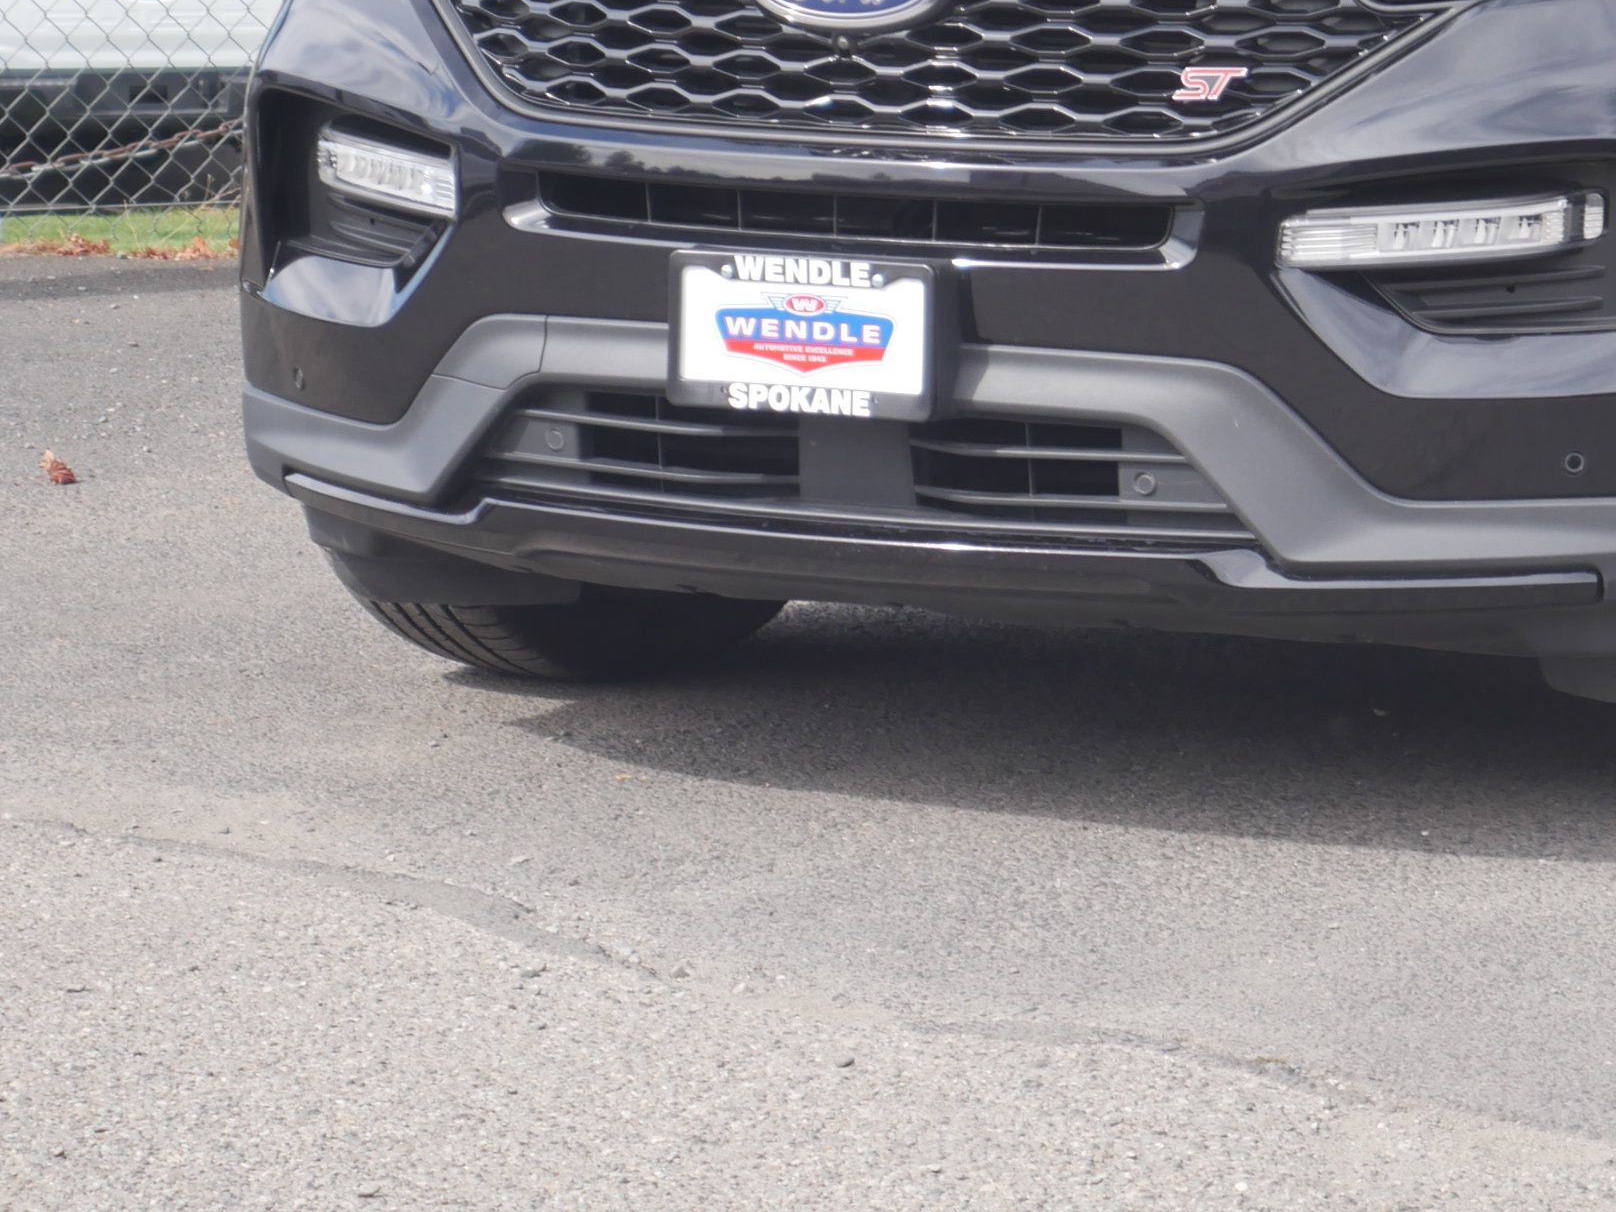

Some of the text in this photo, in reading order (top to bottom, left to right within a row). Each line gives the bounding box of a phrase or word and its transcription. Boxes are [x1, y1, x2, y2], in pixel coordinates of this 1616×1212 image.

[1172, 67, 1248, 100] ST
[734, 254, 871, 288] WENDLE
[791, 298, 818, 312] W
[725, 316, 881, 343] WENDLE
[753, 343, 854, 356] AUTOMOTIVE EXCELLENCE
[783, 353, 807, 362] SINCE
[728, 382, 871, 417] SPOKANE
